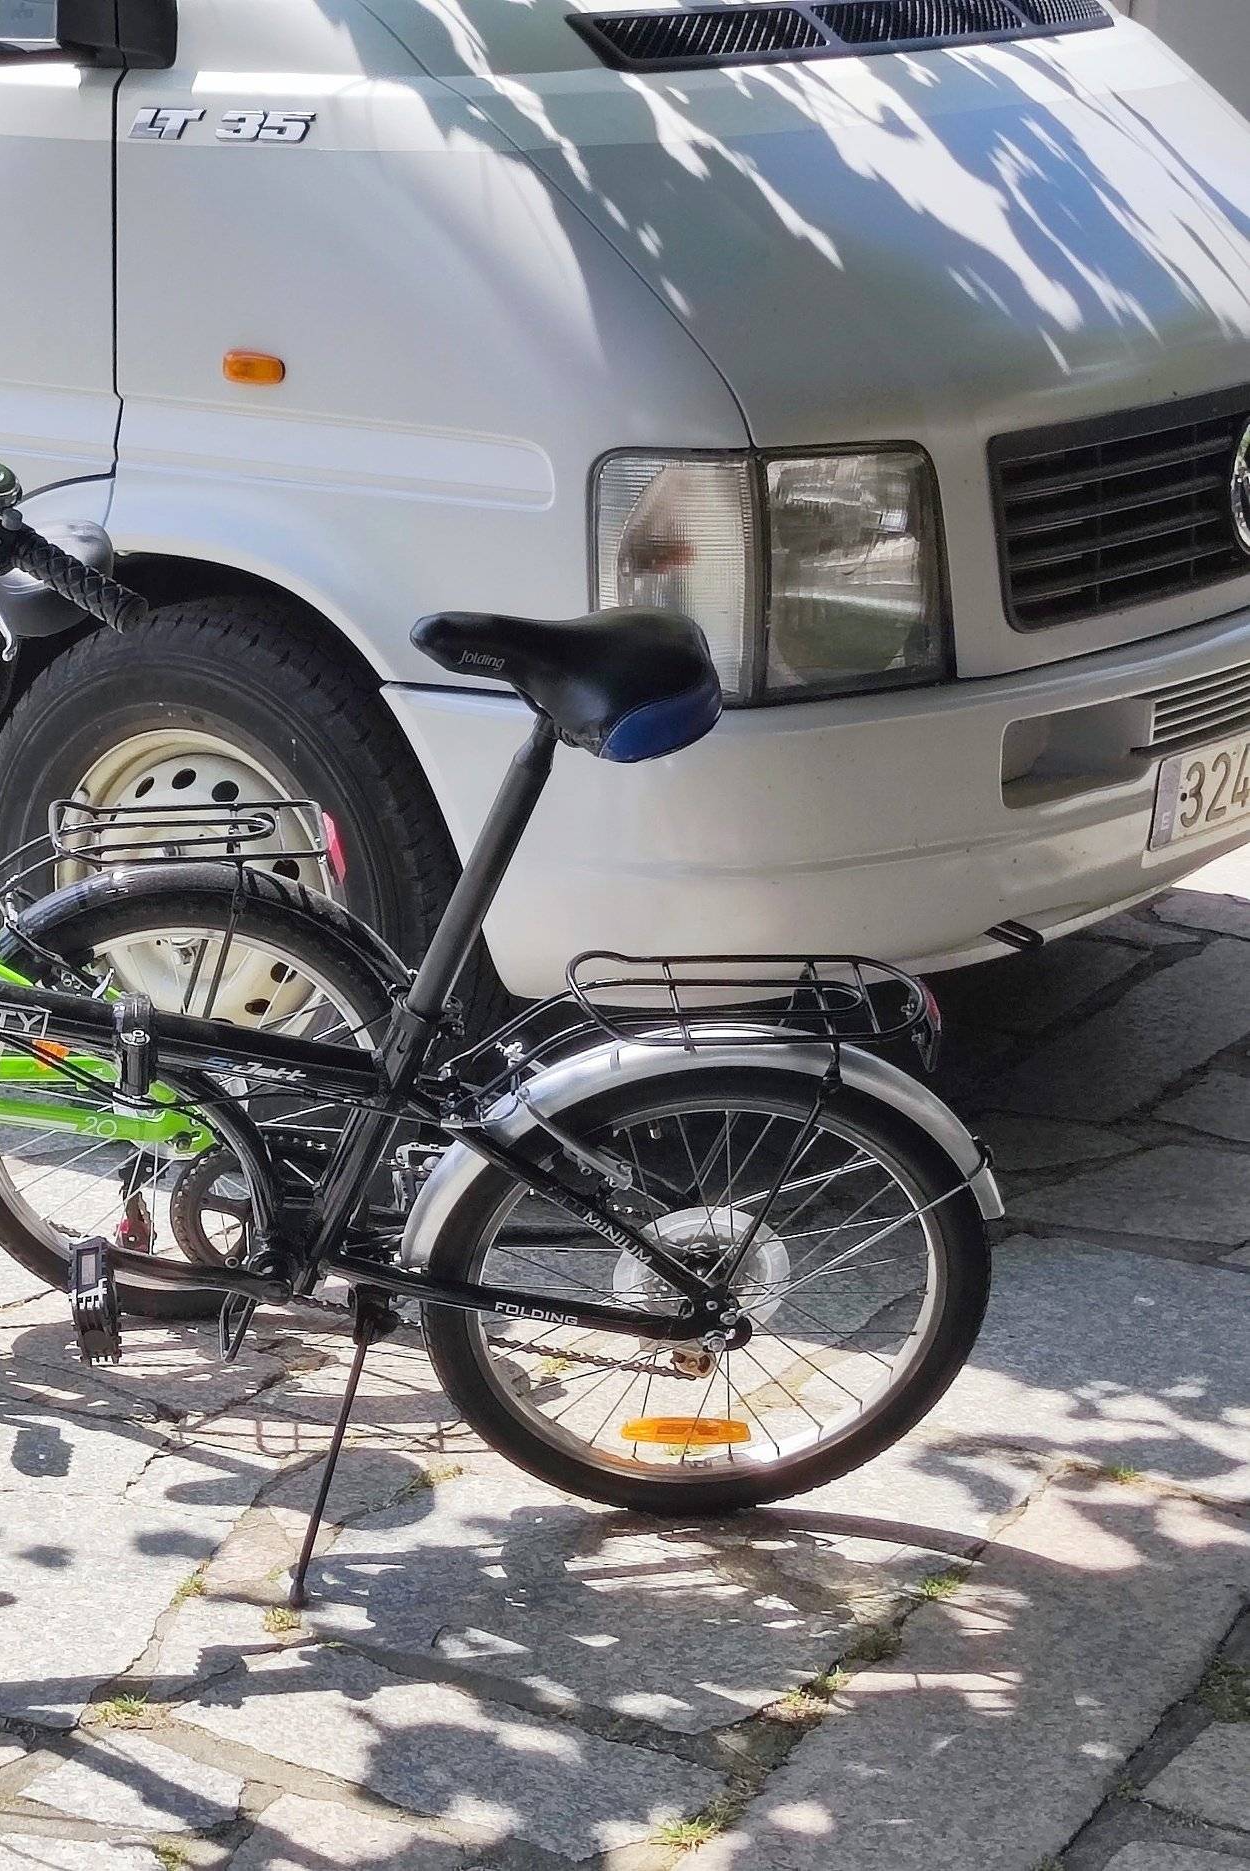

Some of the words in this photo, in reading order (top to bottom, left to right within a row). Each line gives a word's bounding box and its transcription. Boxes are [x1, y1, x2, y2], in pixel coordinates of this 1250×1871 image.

[128, 107, 207, 140] LT
[215, 110, 317, 143] 35
[79, 1116, 117, 1137] 20
[494, 1301, 579, 1326] FOLDING
